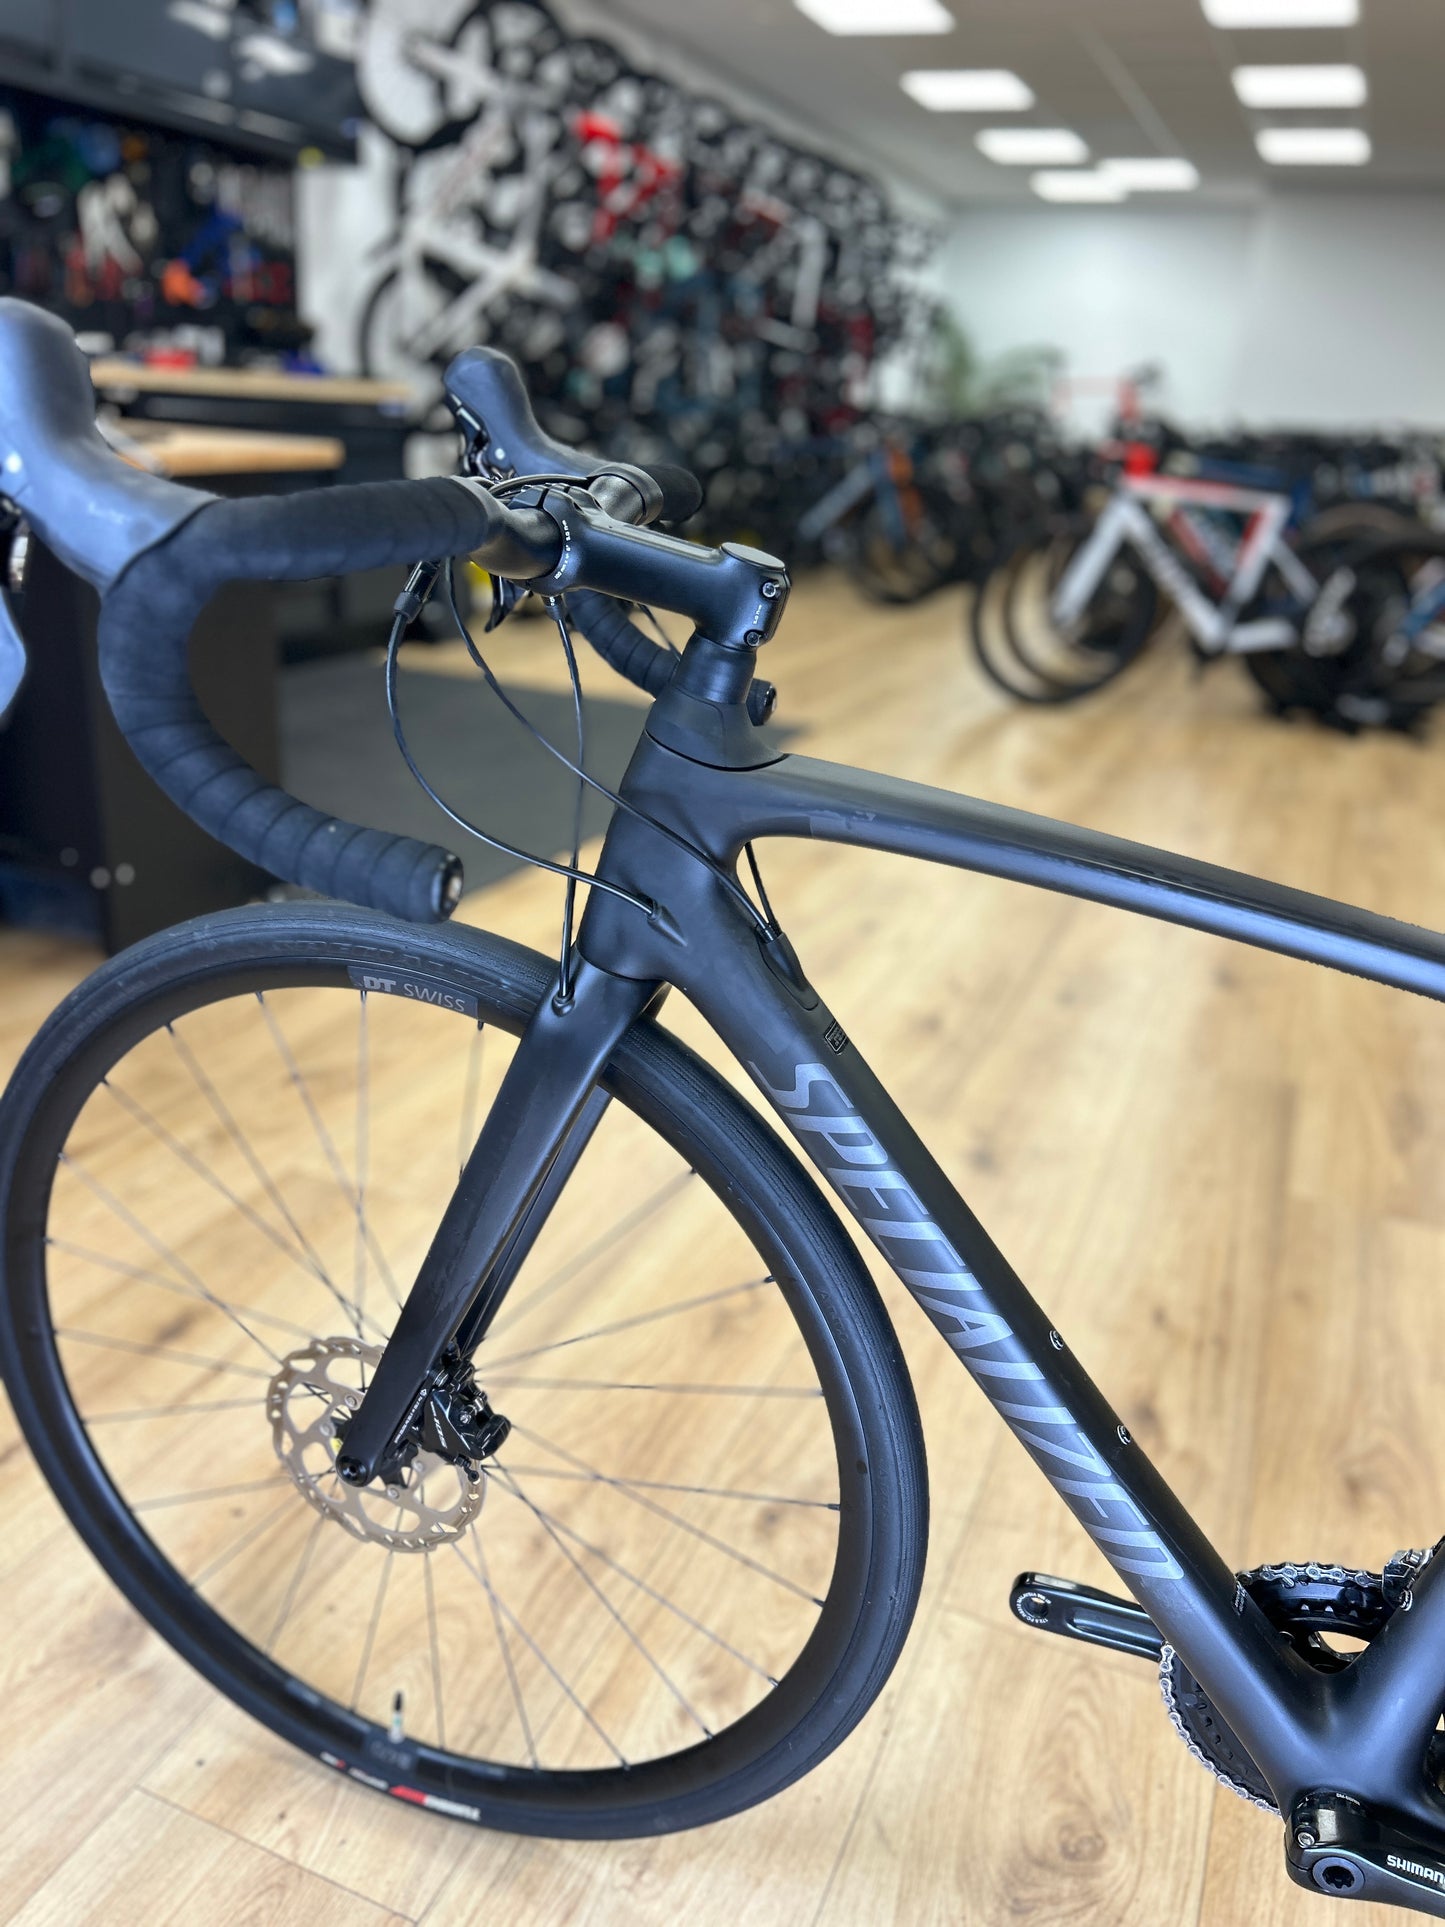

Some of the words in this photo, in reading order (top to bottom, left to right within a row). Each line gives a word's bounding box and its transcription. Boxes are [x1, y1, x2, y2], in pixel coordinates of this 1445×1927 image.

[363, 975, 396, 992] DT
[402, 982, 465, 1012] SWISS
[747, 1061, 1185, 1580] SPECIALIZED
[433, 1417, 448, 1449] 105
[1386, 1854, 1445, 1886] SHIMAN
